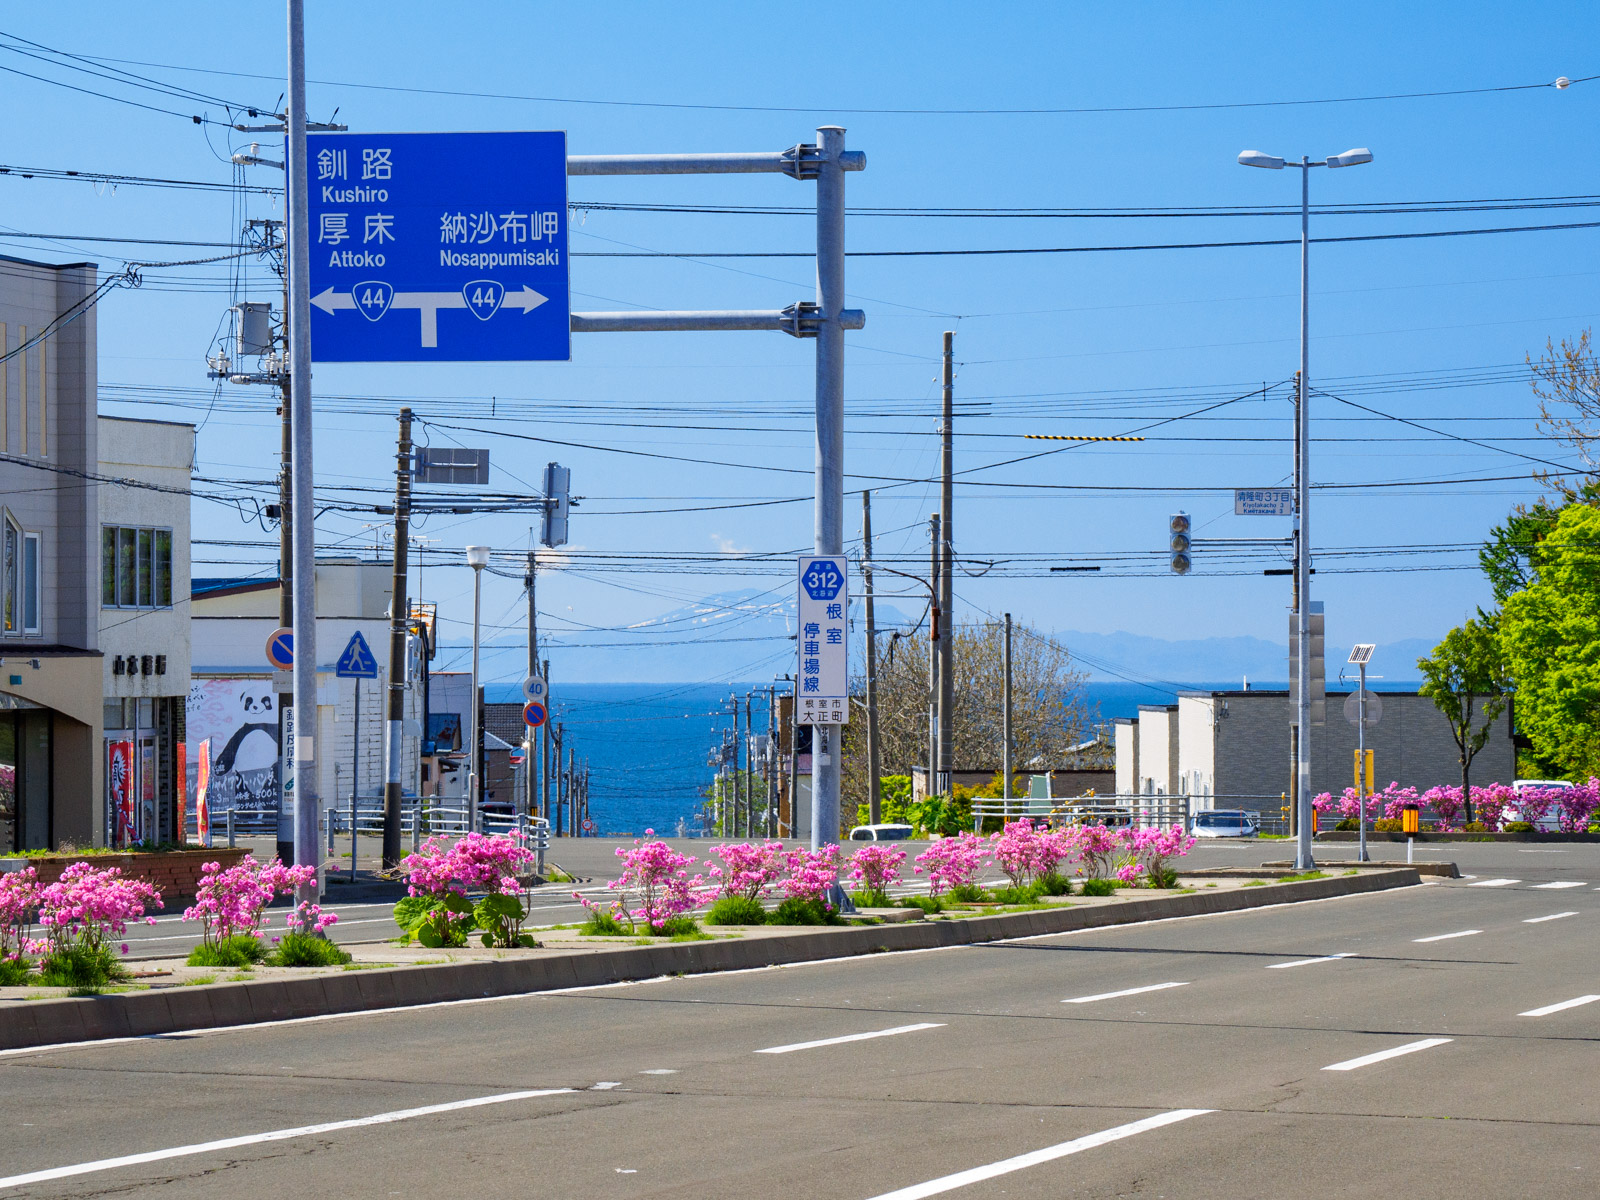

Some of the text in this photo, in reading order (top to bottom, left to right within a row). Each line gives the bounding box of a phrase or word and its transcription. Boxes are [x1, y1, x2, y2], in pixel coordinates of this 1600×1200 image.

[317, 148, 393, 180] 釧路
[322, 186, 388, 203] Kushiro
[318, 212, 395, 245] 厚床
[440, 210, 558, 245] 納沙布岬
[329, 250, 386, 268] Attoko
[440, 249, 559, 270] Nosappumisaki
[361, 288, 385, 308] 44
[472, 287, 495, 307] 44
[808, 572, 838, 588] 312
[826, 603, 843, 645] 根室
[803, 622, 820, 693] 停車場線
[528, 683, 543, 695] 40
[805, 699, 841, 709] 根室市
[803, 711, 843, 722] 大正町
